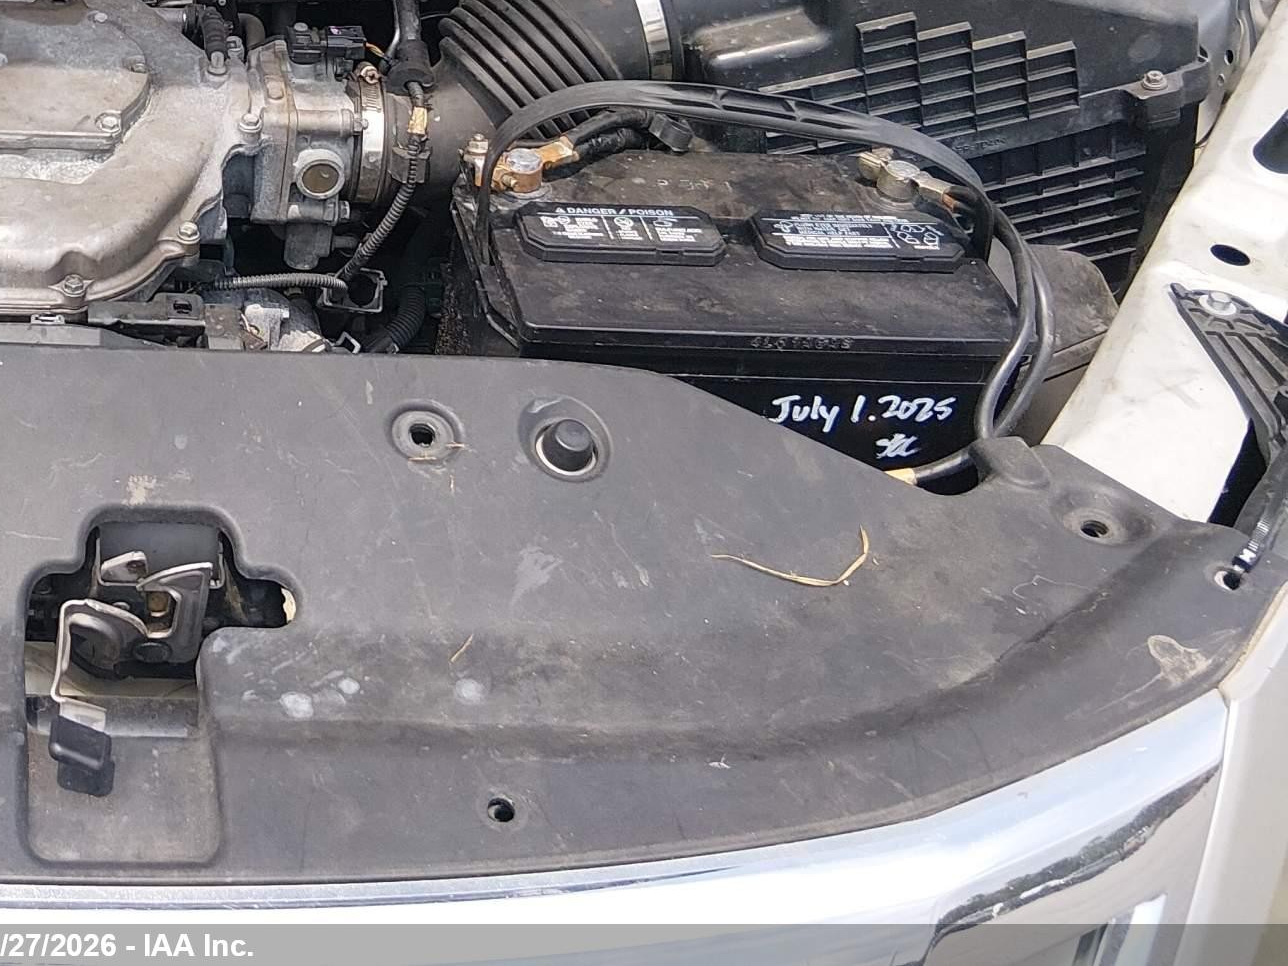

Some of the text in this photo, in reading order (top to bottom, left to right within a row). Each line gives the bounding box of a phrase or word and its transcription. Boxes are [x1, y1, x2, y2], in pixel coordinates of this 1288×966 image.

[566, 207, 617, 215] DANGER
[628, 208, 673, 216] POISON
[768, 395, 840, 433] July
